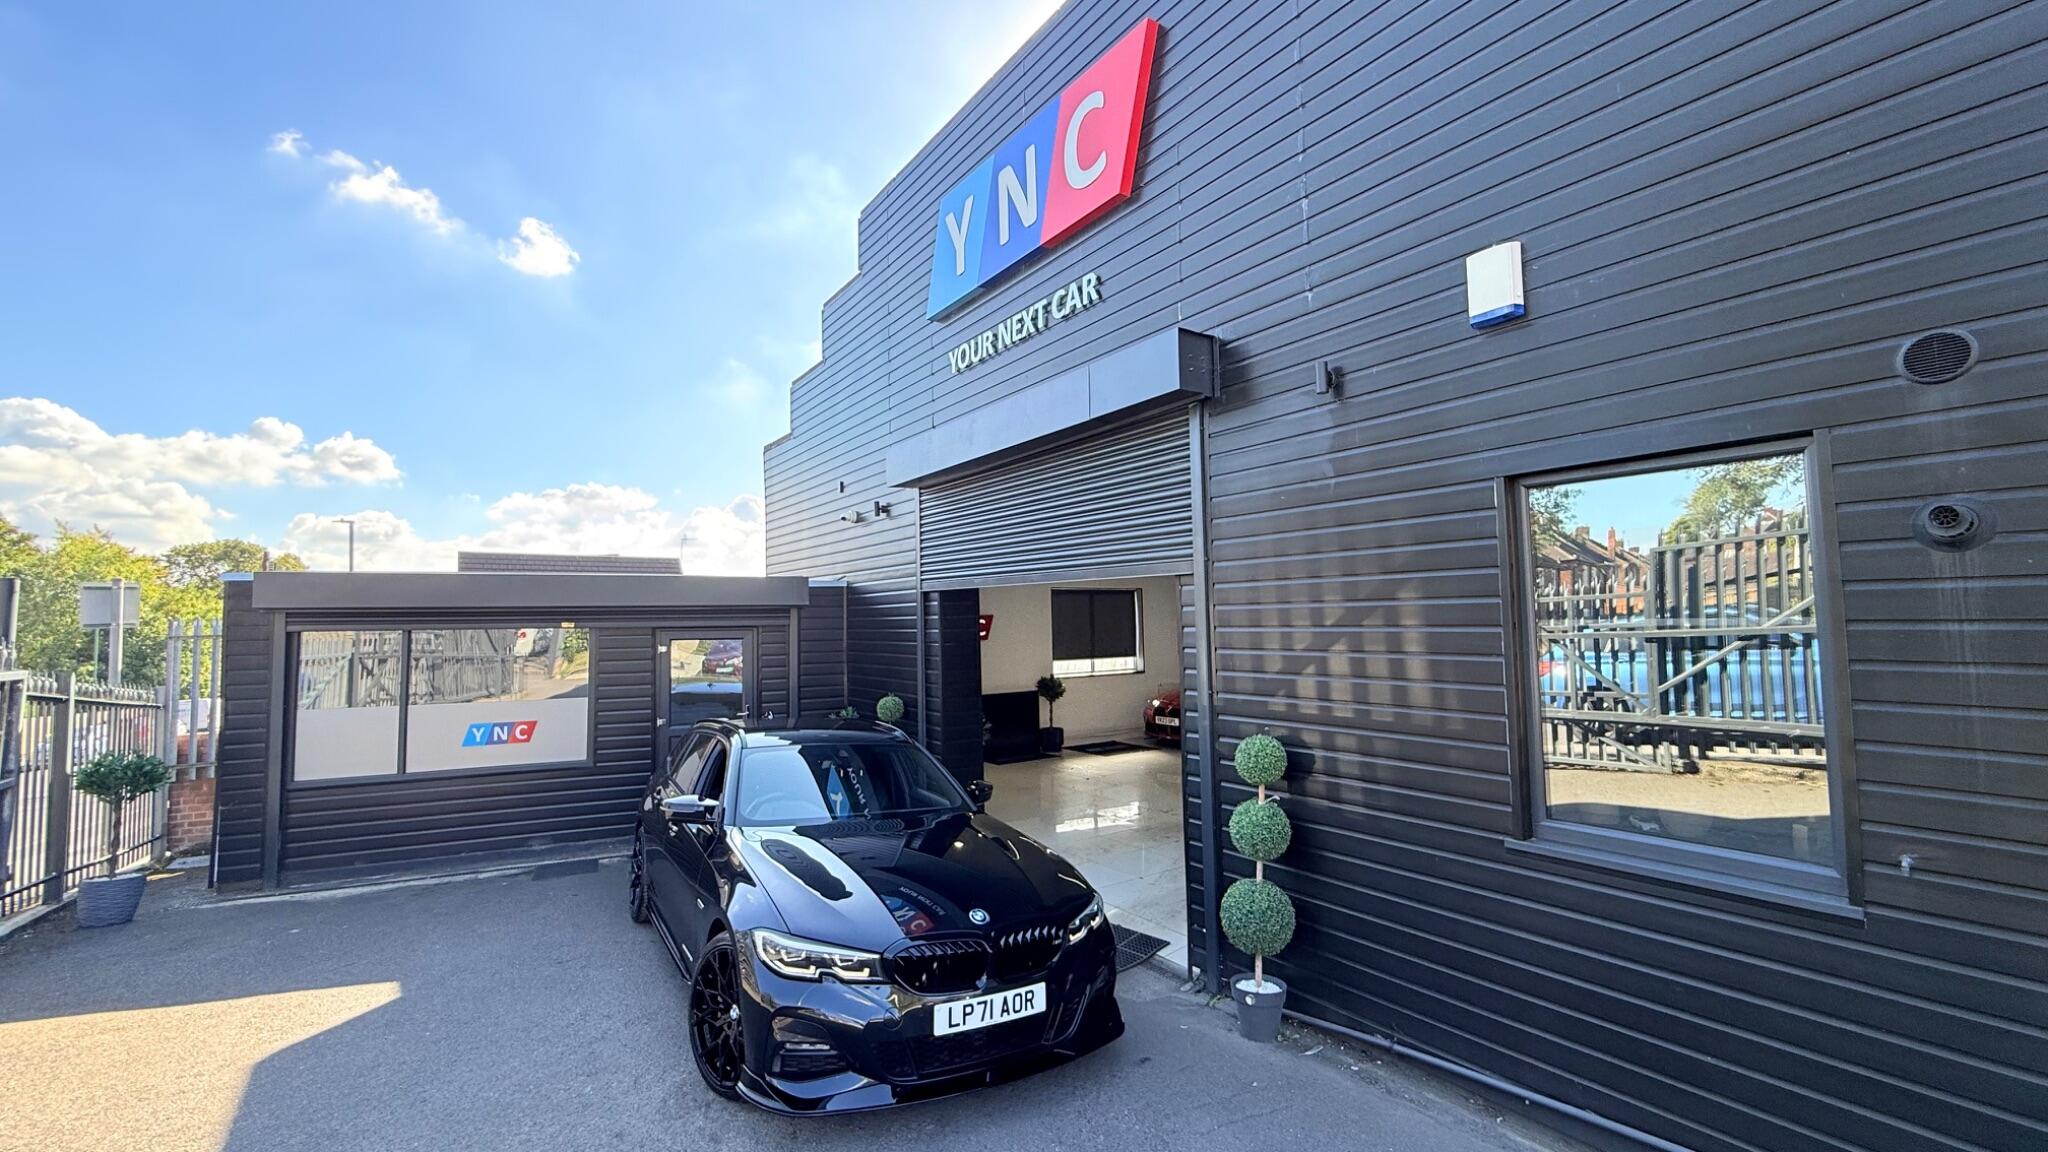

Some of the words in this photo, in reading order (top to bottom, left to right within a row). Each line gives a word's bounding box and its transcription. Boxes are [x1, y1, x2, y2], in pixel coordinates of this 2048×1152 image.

[945, 90, 1107, 276] YNC
[948, 330, 994, 374] YOUR
[998, 298, 1047, 350] NEXT
[1051, 272, 1099, 319] CAR
[471, 724, 528, 743] YNC
[948, 998, 994, 1028] LP71
[1000, 989, 1035, 1018] AOR
